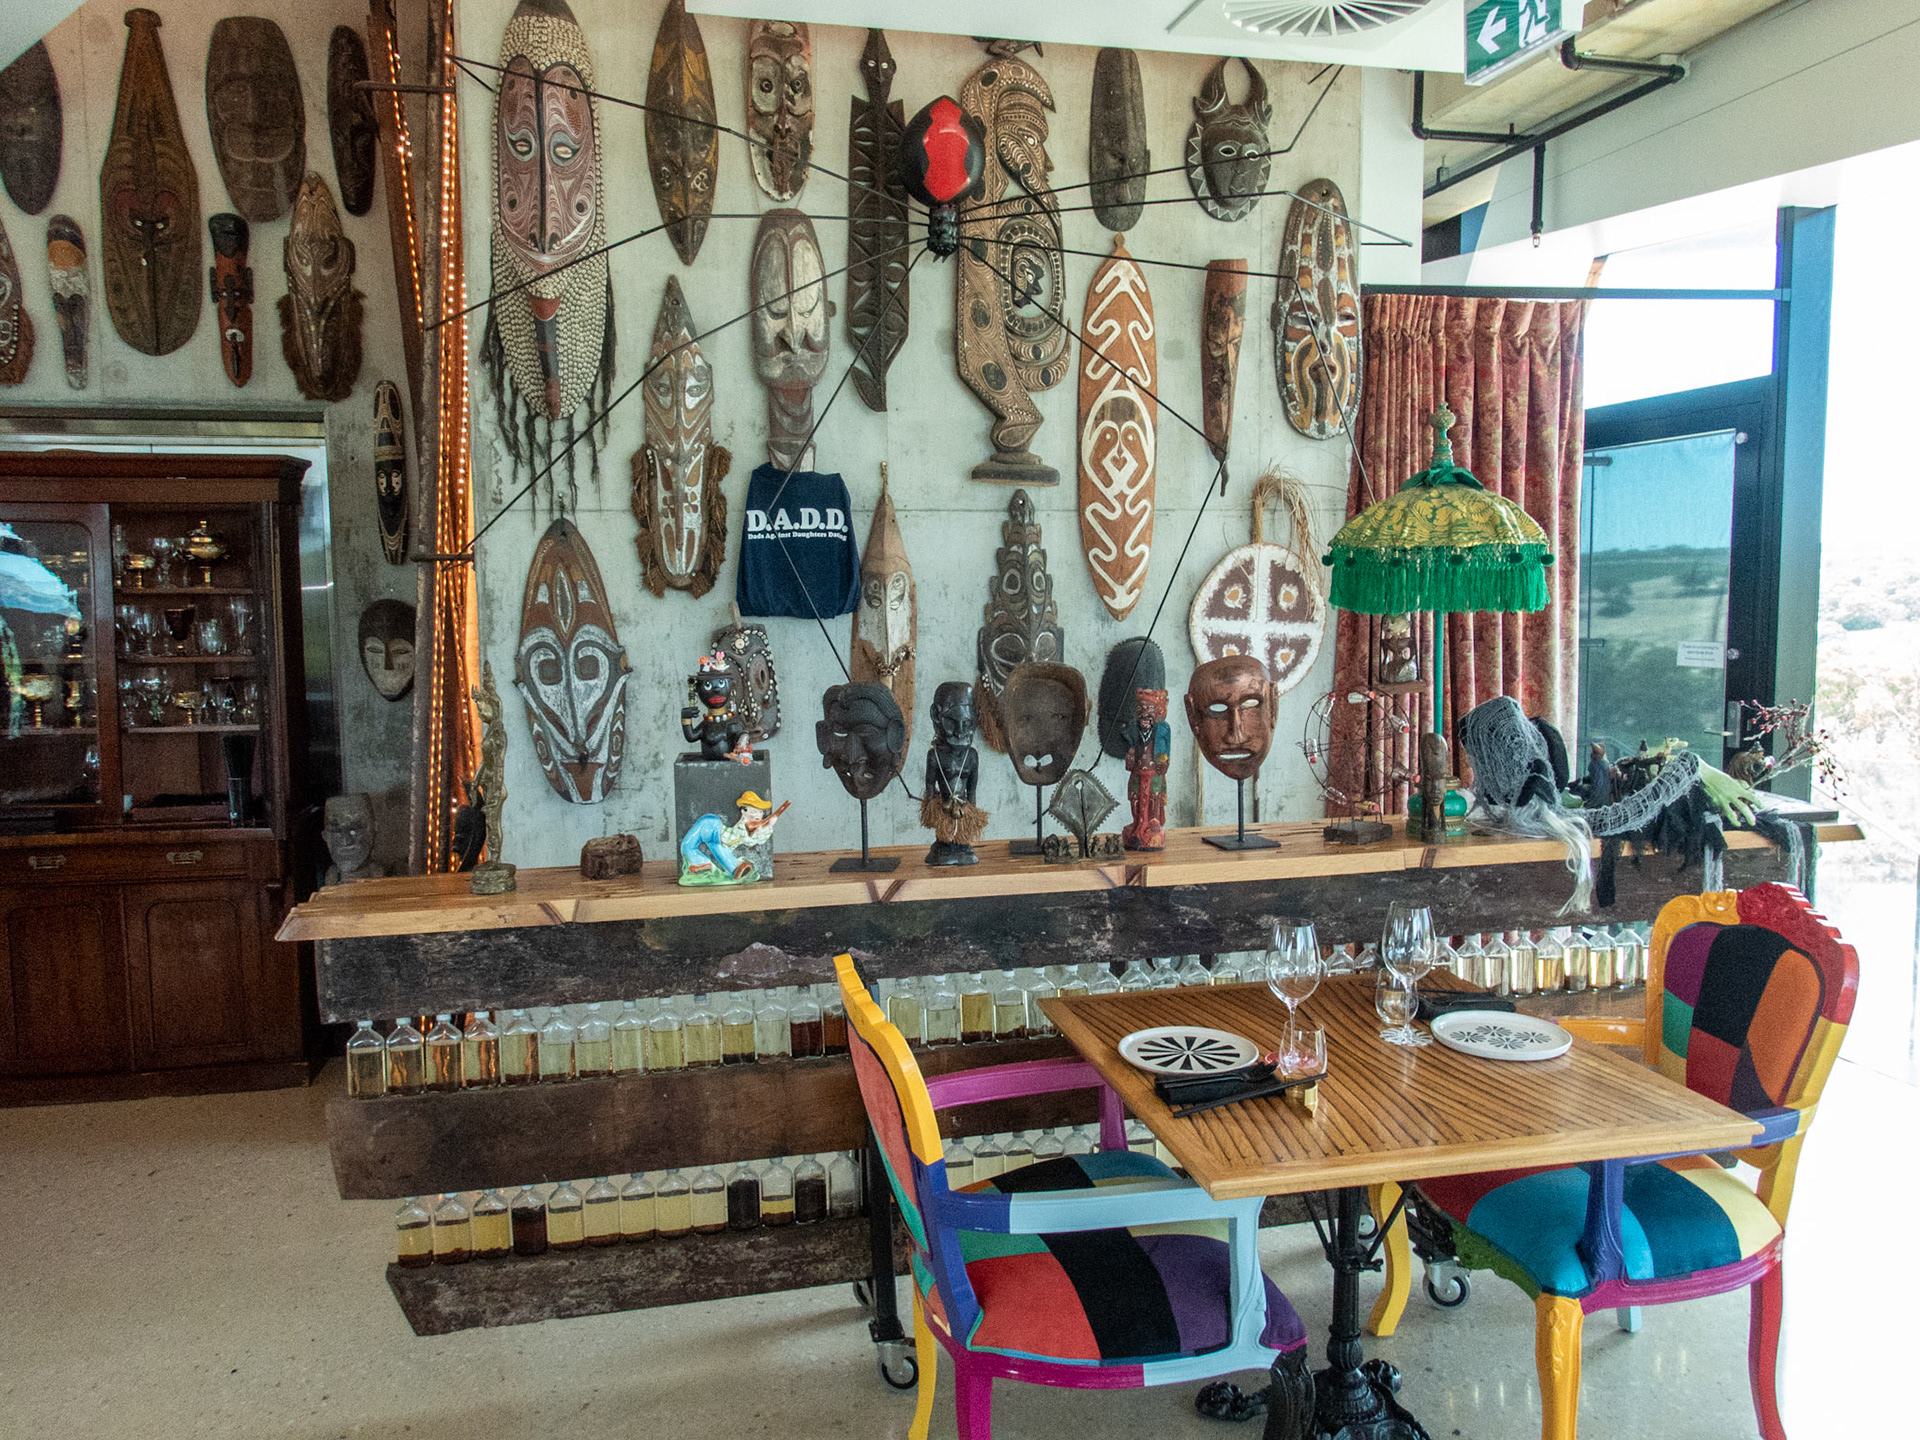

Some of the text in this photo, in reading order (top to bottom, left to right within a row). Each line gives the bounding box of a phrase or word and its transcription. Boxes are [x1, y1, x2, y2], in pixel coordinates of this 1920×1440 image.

[746, 508, 849, 533] D.A.D.D.
[765, 532, 791, 540] Aginst
[792, 531, 827, 539] Daughters
